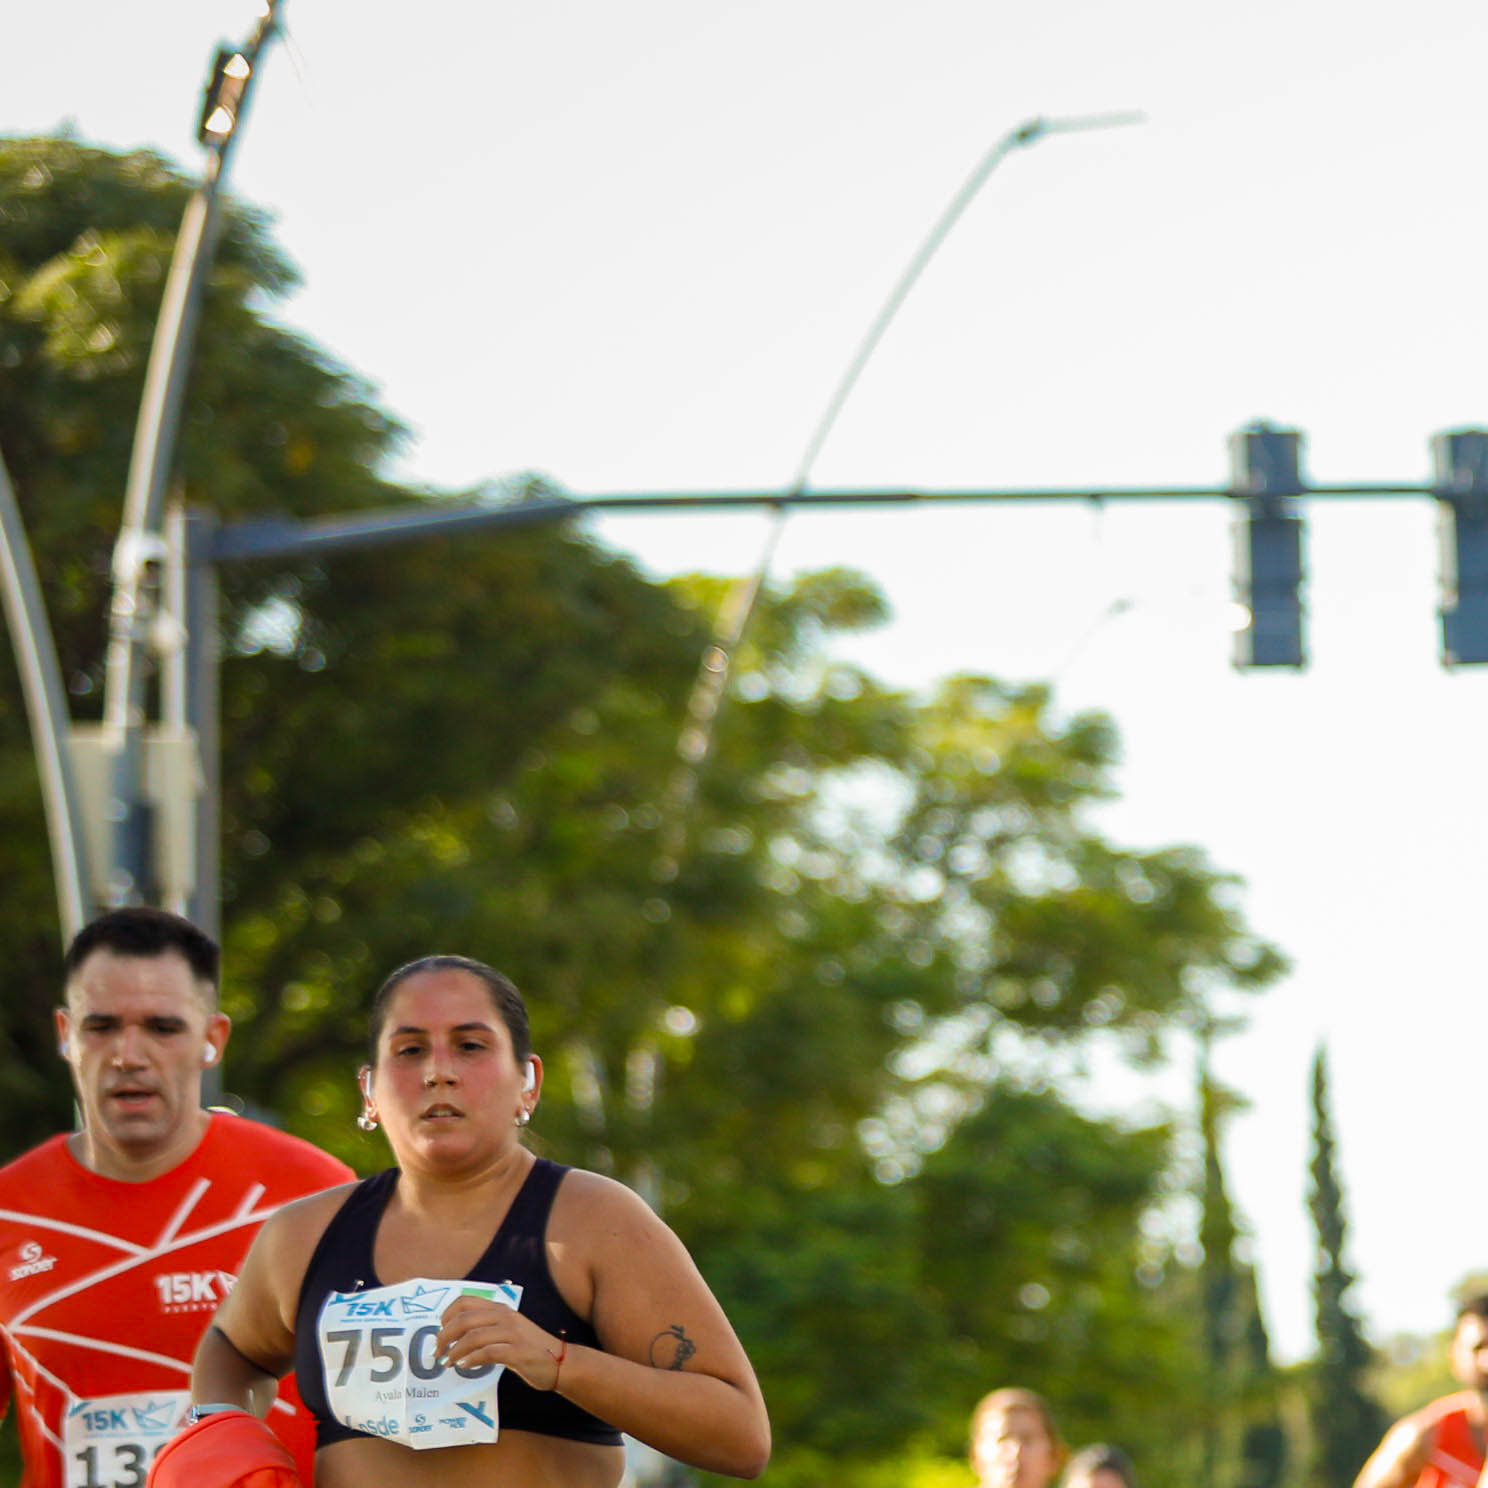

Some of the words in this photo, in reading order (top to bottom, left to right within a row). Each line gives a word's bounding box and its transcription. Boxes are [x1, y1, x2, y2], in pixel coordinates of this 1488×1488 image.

[156, 1272, 218, 1305] 15K
[344, 1298, 395, 1317] 15K
[82, 1409, 129, 1431] 15K
